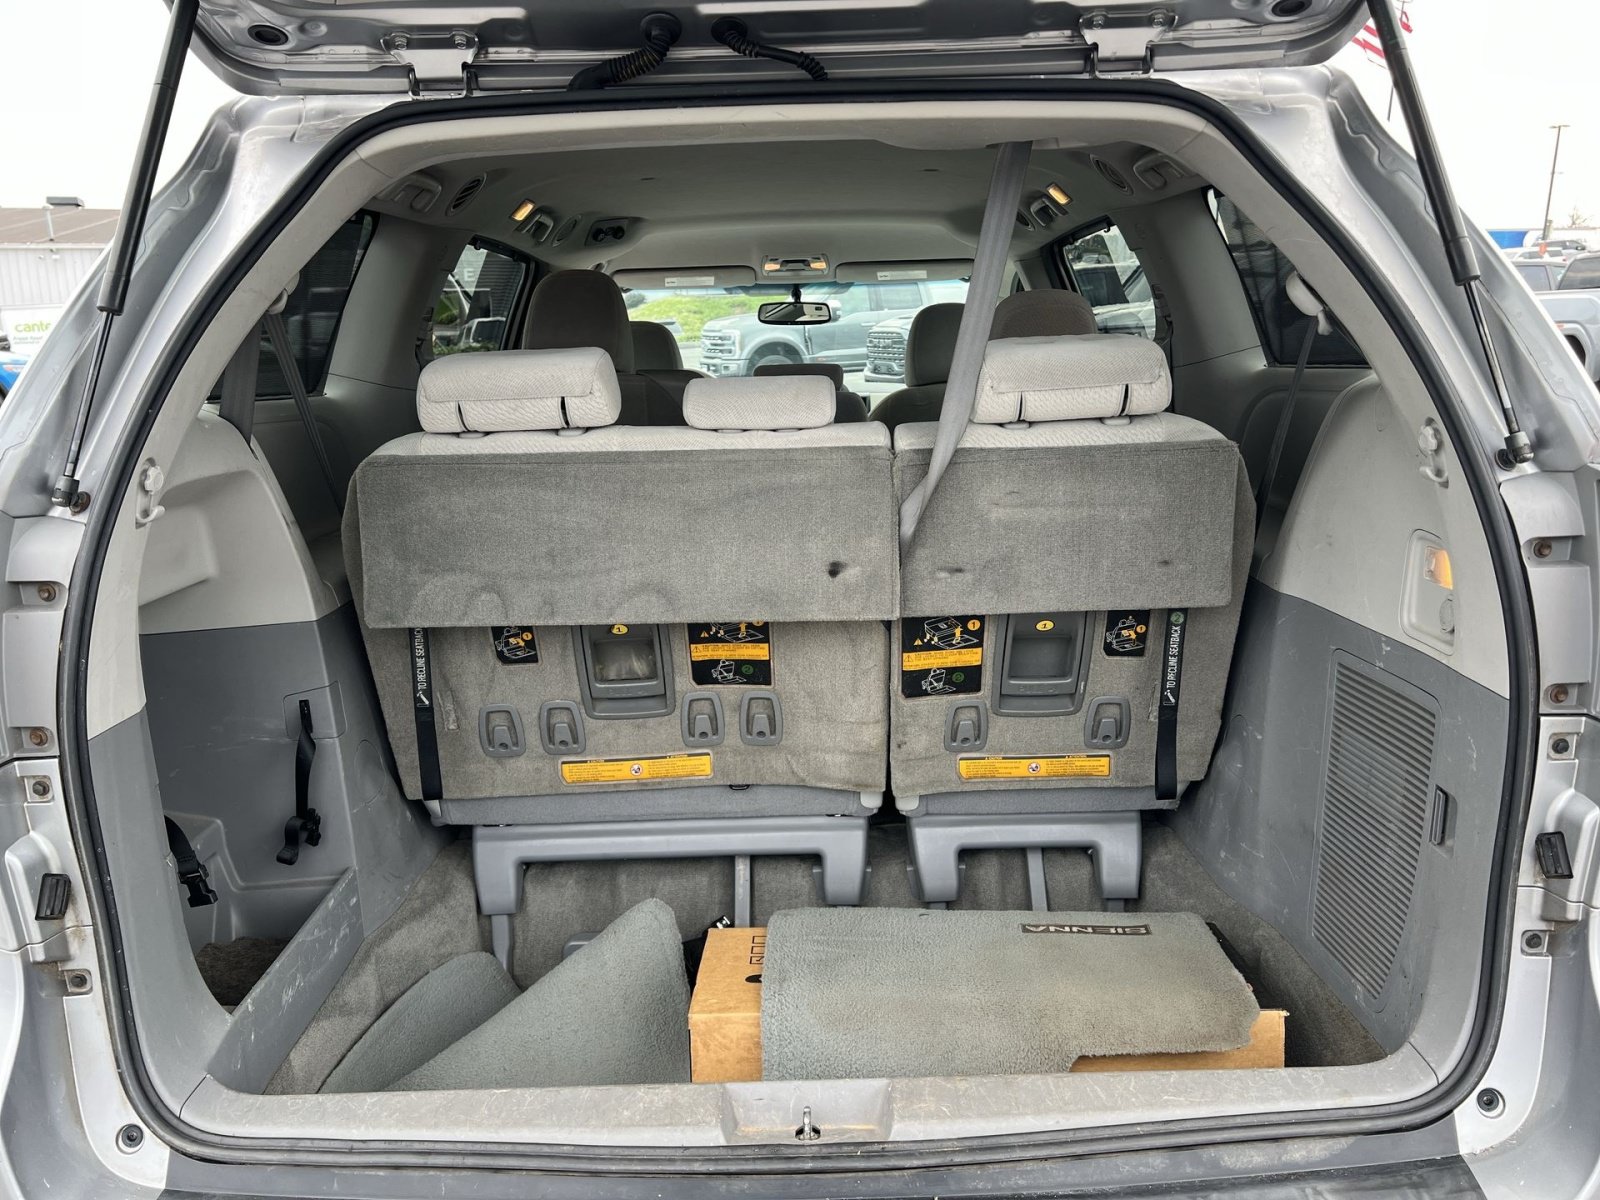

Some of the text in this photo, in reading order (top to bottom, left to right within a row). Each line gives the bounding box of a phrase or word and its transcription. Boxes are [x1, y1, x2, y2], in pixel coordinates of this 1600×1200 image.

[1167, 625, 1181, 689] TO RECLINE SEATBACK
[416, 657, 427, 682] RECLINE
[417, 682, 427, 690] TO
[1025, 925, 1147, 934] SIENNA
